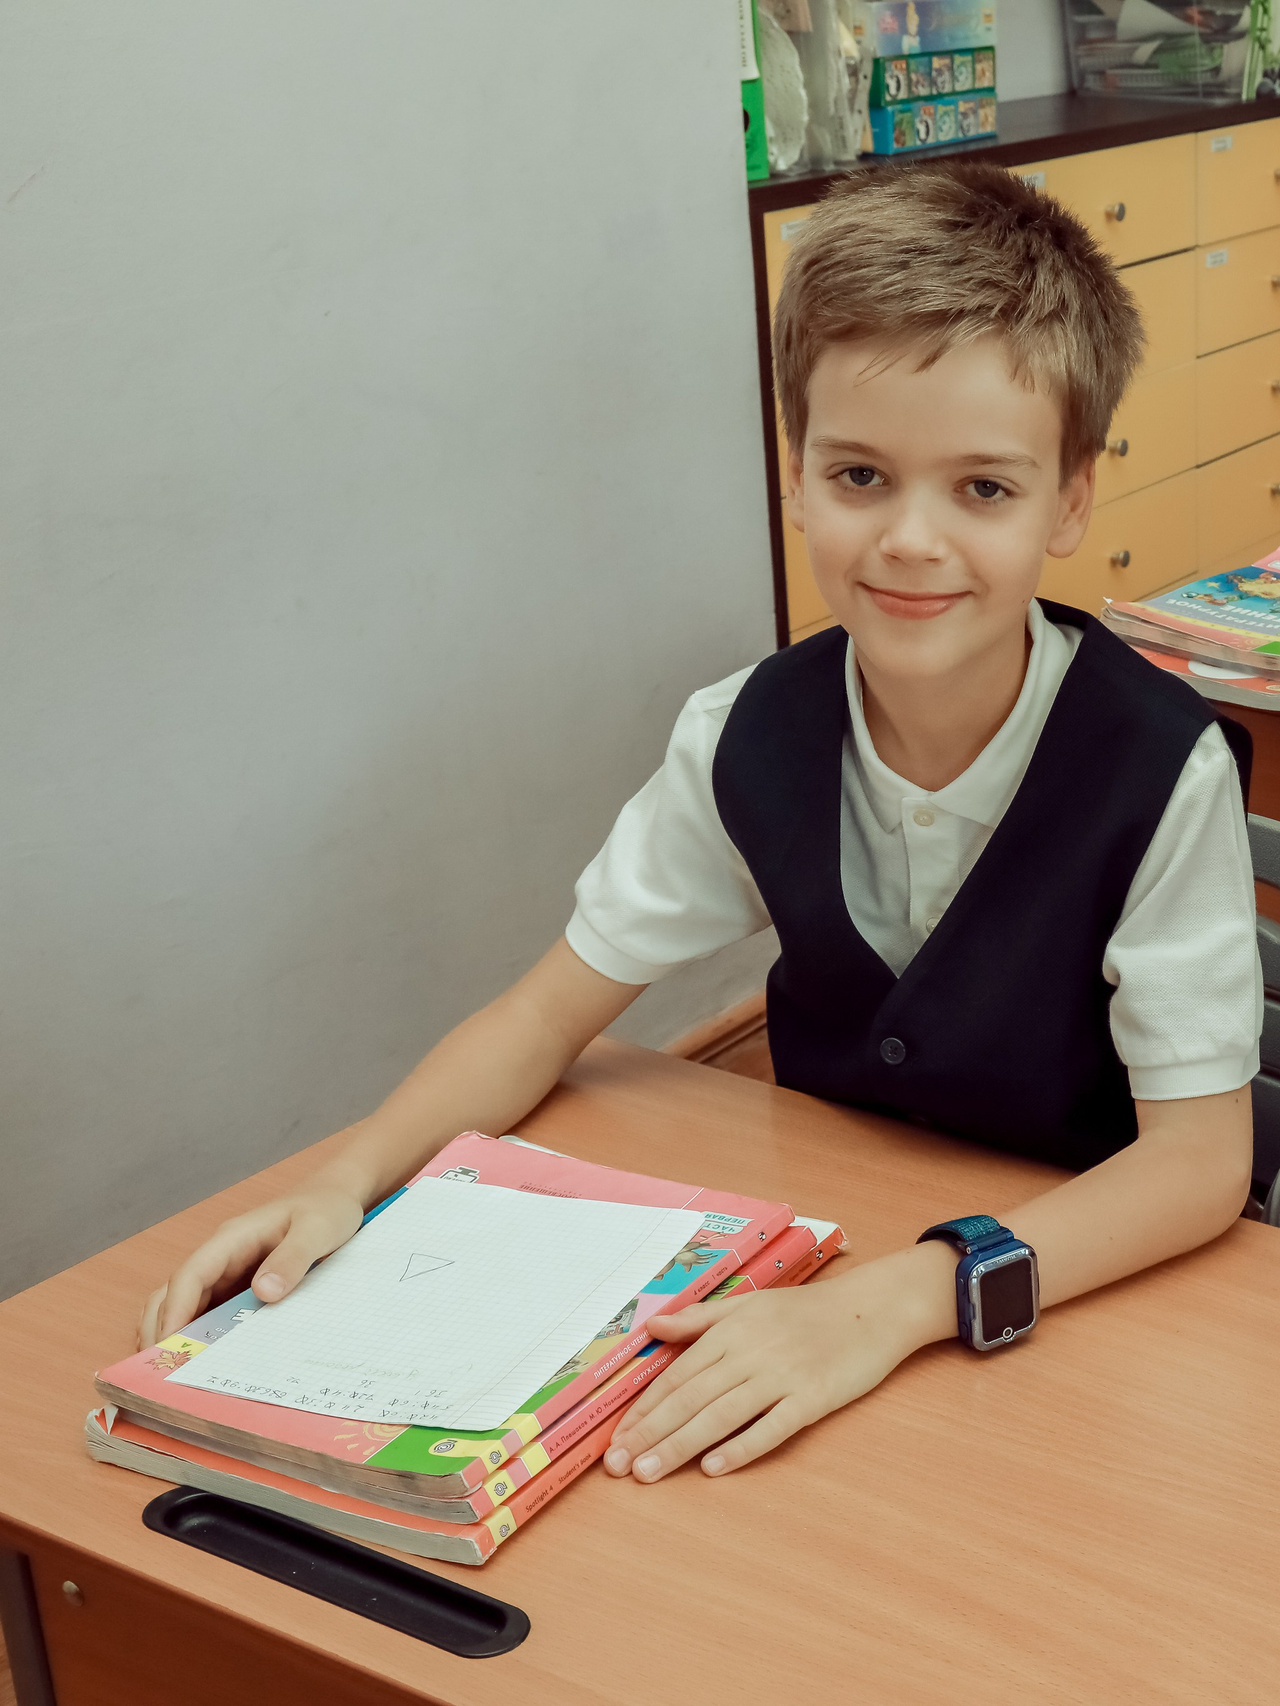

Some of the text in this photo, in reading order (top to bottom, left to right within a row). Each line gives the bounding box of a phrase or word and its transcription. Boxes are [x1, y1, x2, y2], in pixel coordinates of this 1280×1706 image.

[703, 1223, 735, 1232] ЧАСТ
[704, 1212, 746, 1225] ПЕРВАЯ
[593, 1345, 632, 1379] ЛИТЕРАТУРНОЕ
[632, 1350, 674, 1385] ОКРУЖАЮЩИЙ
[525, 1489, 549, 1513] Spotlight
[558, 1462, 580, 1484] Student's
[580, 1453, 592, 1466] Book
